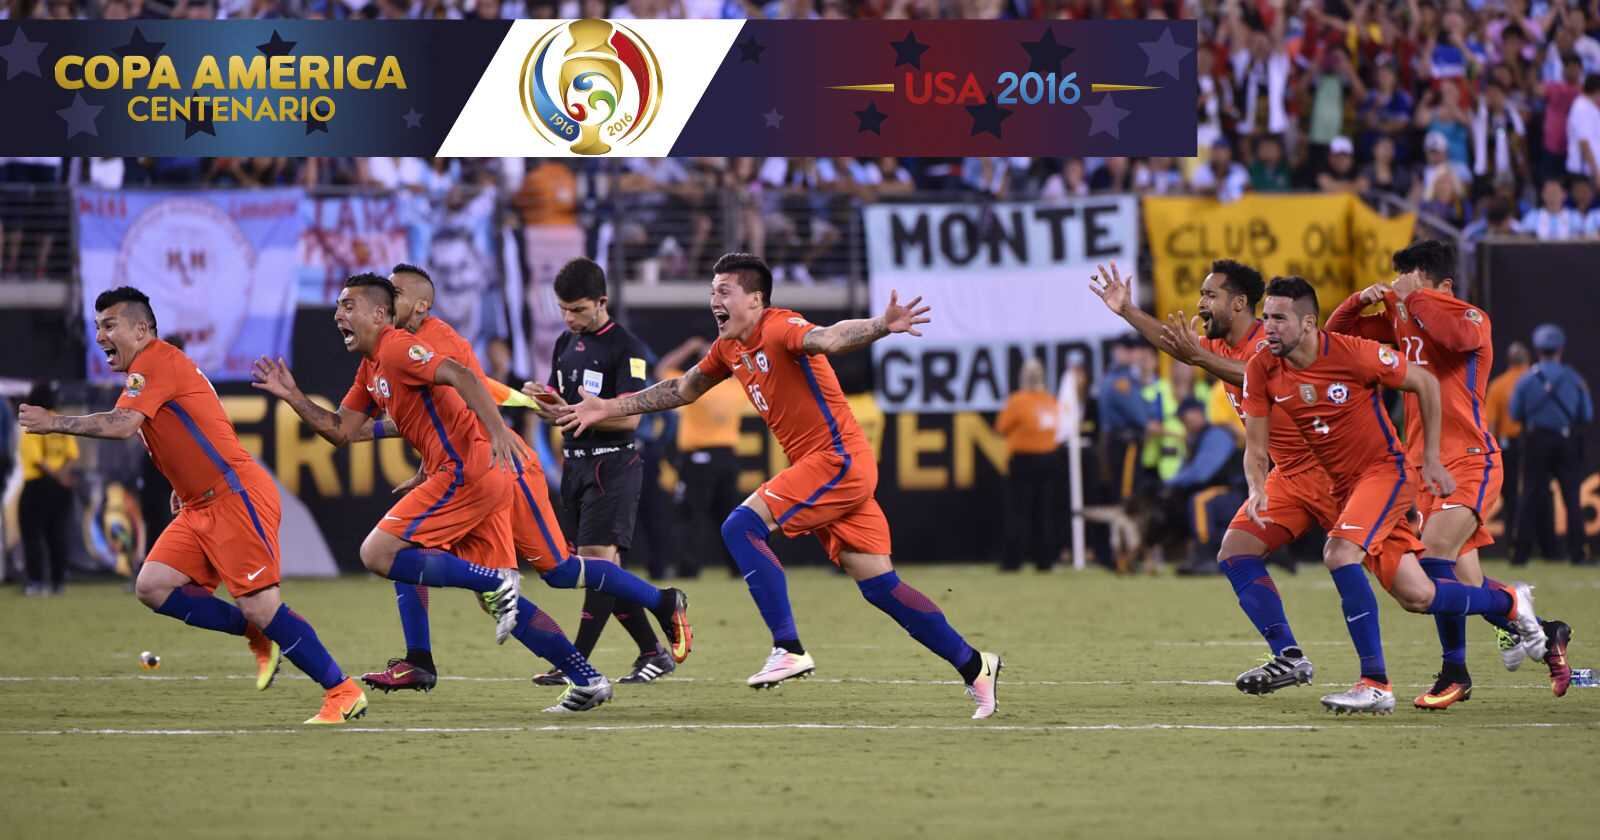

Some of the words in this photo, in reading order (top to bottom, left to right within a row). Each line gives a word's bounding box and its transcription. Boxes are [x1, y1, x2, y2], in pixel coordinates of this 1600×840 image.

[889, 203, 1123, 269] MONTE
[1166, 218, 1278, 259] CLUB
[748, 384, 769, 412] 16
